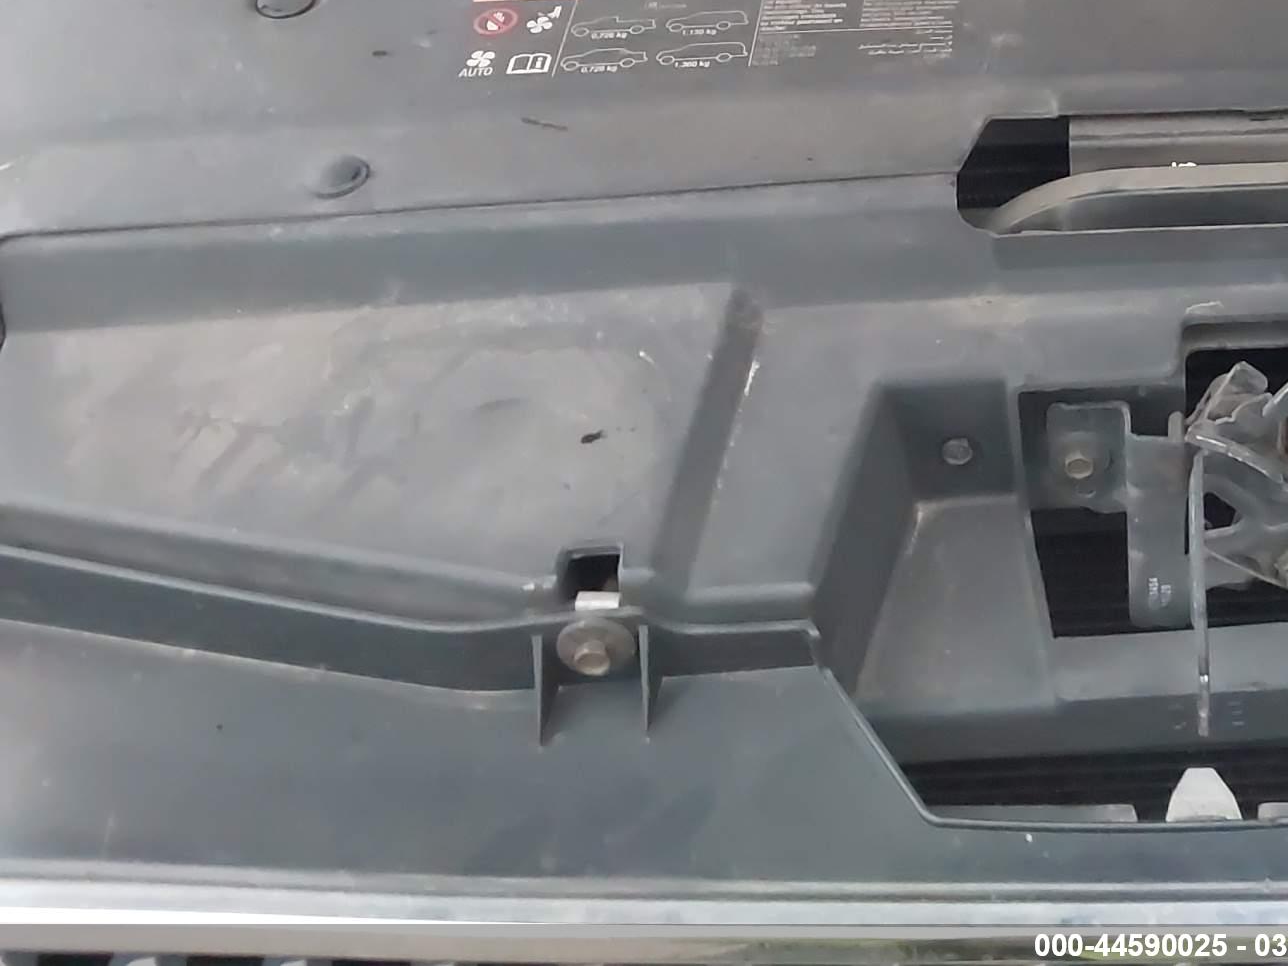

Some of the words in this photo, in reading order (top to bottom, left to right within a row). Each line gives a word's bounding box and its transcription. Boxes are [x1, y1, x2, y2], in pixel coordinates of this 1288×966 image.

[615, 31, 627, 39] kg
[699, 60, 710, 68] kg
[458, 67, 493, 77] AUTO
[606, 65, 617, 73] kg
